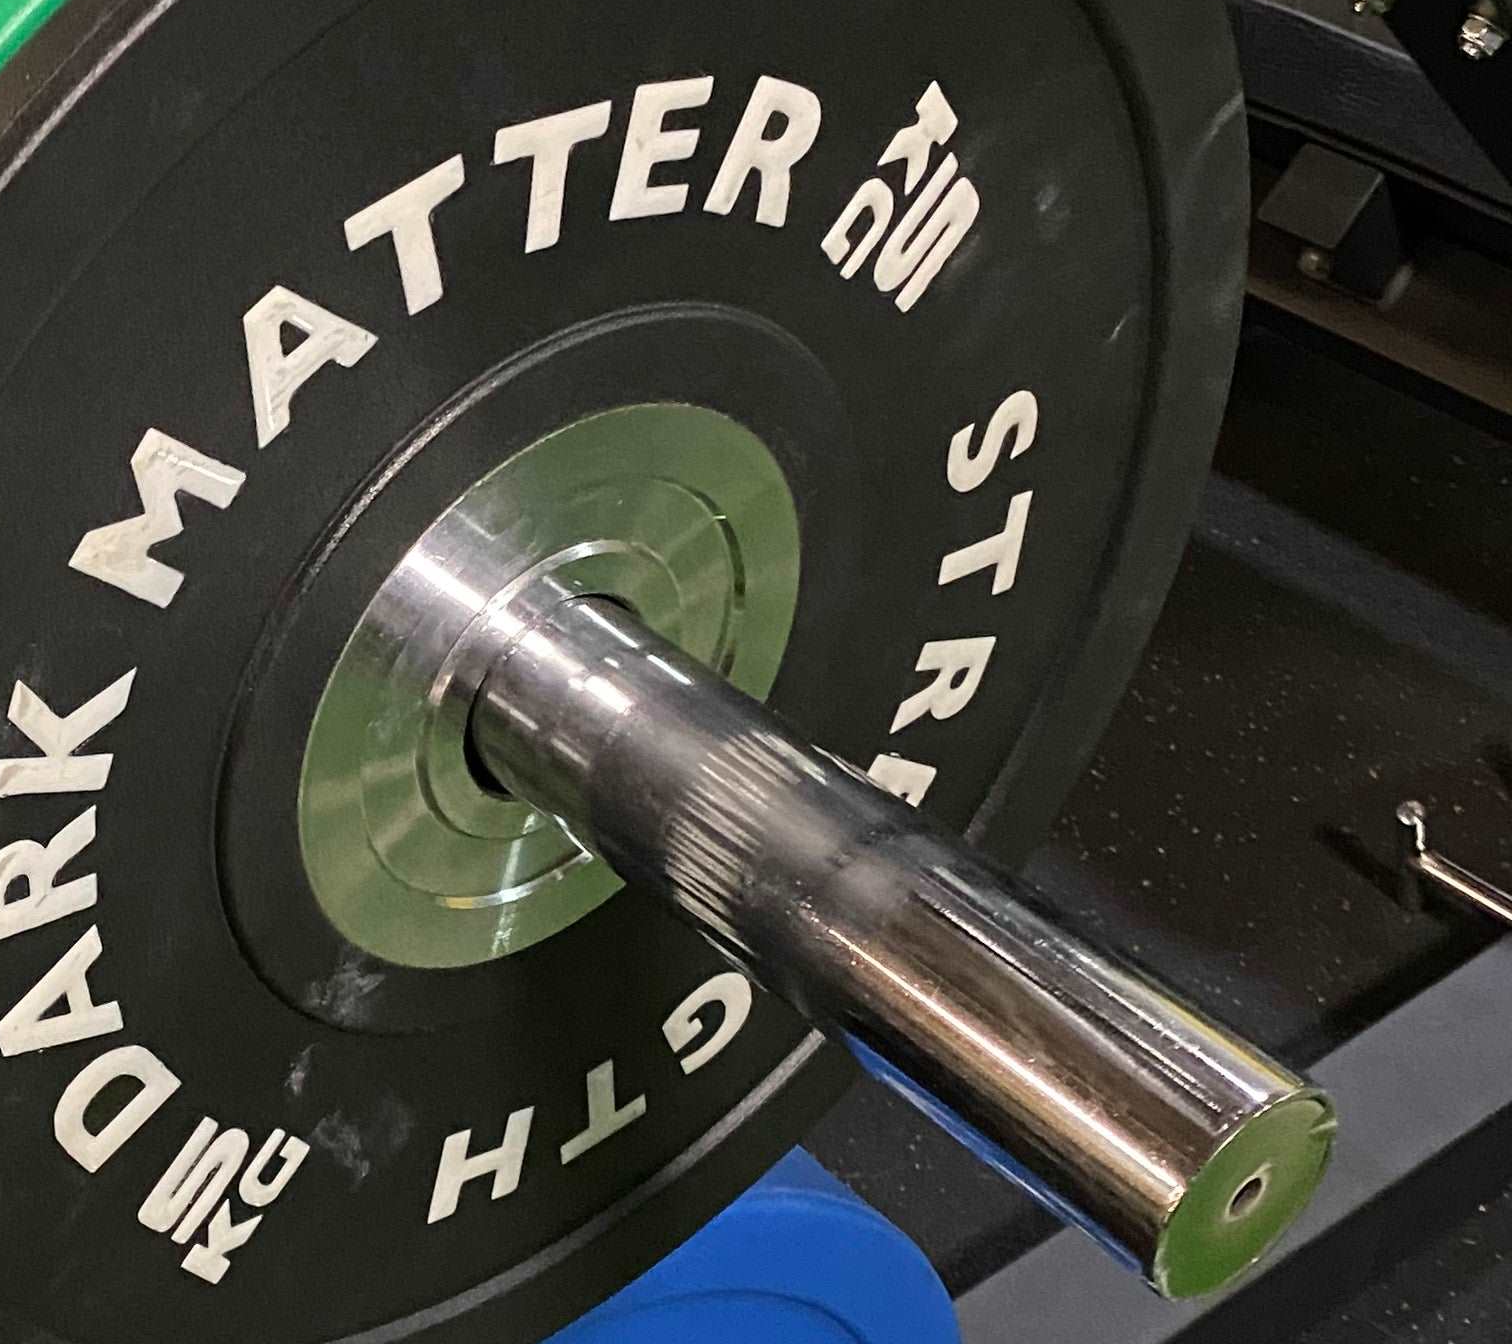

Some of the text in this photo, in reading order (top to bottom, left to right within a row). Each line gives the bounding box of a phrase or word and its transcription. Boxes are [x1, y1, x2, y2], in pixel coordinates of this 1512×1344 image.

[67, 74, 822, 609] MATTER
[820, 79, 959, 280] KG
[428, 389, 1039, 1225] STRGTH
[180, 1128, 311, 1285] KG
